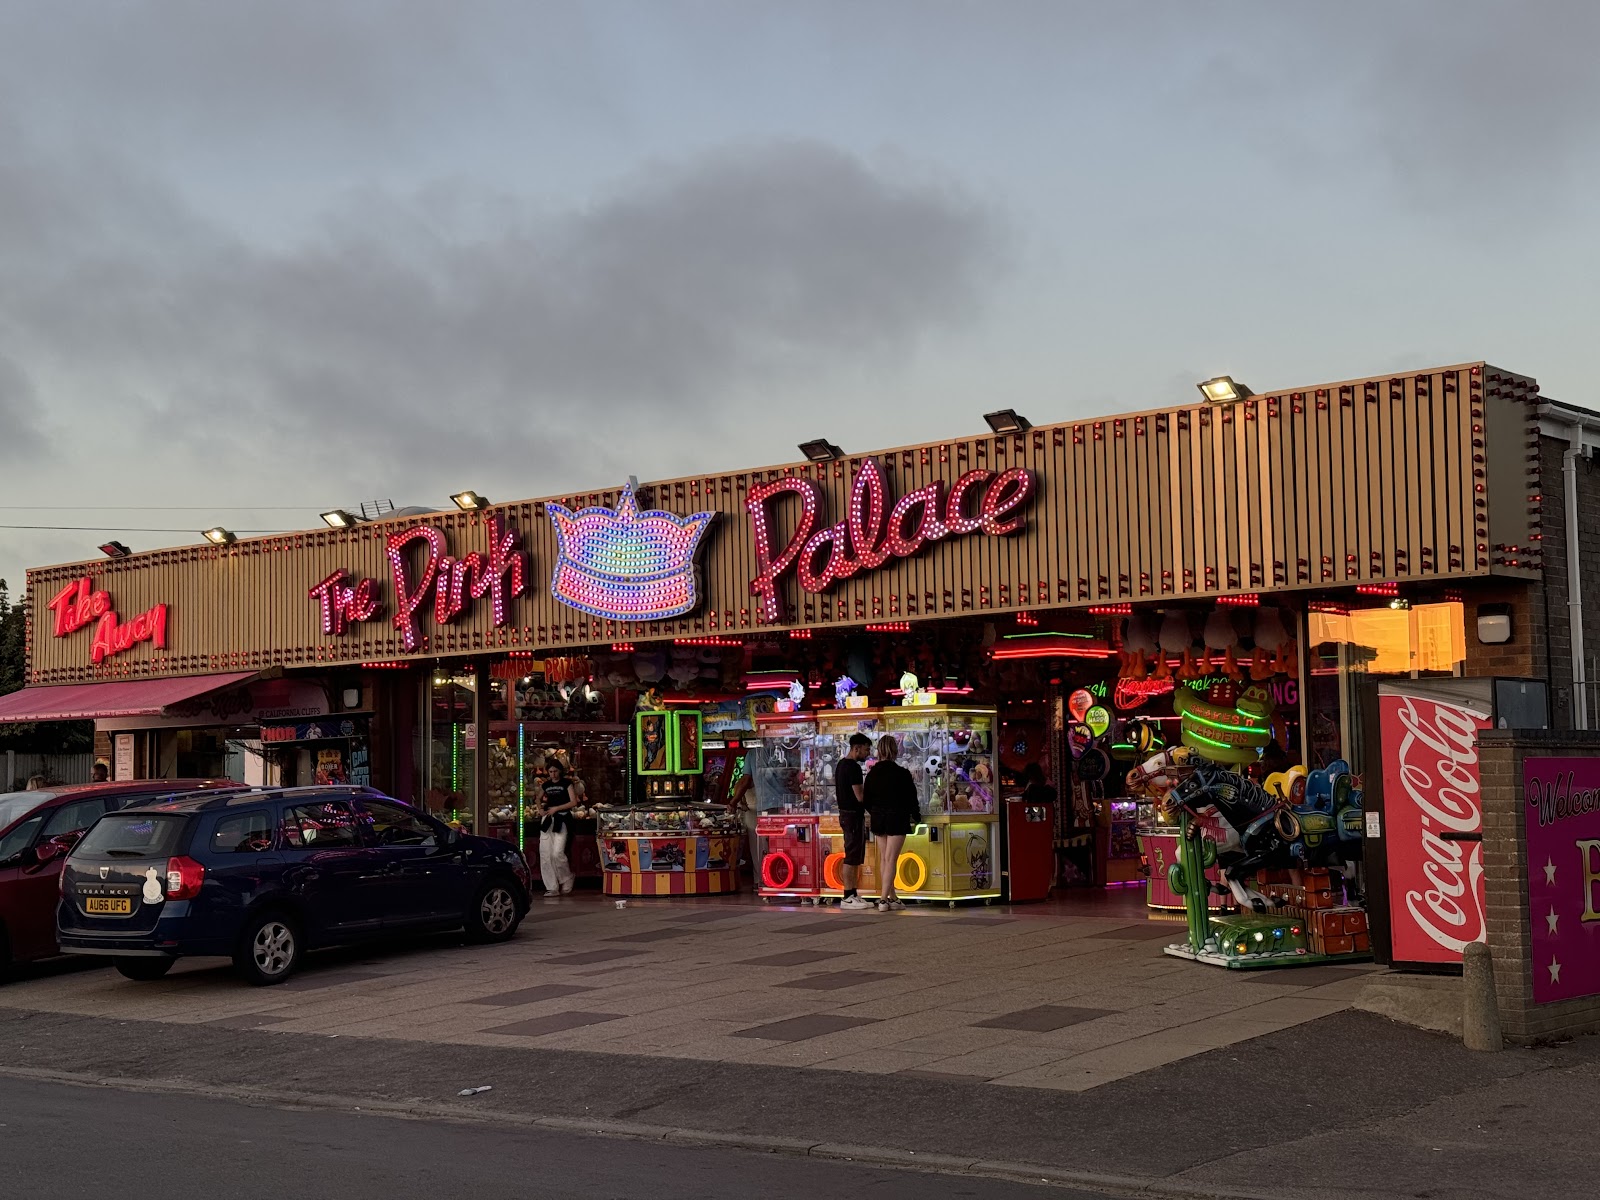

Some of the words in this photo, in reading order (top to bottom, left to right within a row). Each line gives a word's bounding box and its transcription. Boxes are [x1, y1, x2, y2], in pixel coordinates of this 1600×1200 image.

[308, 568, 382, 637] The
[384, 513, 530, 654] Pink
[744, 456, 1036, 624] Palace
[46, 577, 111, 638] Take
[90, 603, 167, 664] Away
[265, 708, 301, 718] CALIFORNIA
[301, 707, 321, 716] CLIFFS
[1189, 722, 1249, 743] LADDERS
[352, 750, 368, 768] CAN
[1398, 696, 1487, 953] Coca-Cola
[89, 900, 109, 911] AU66
[110, 900, 127, 911] UFG
